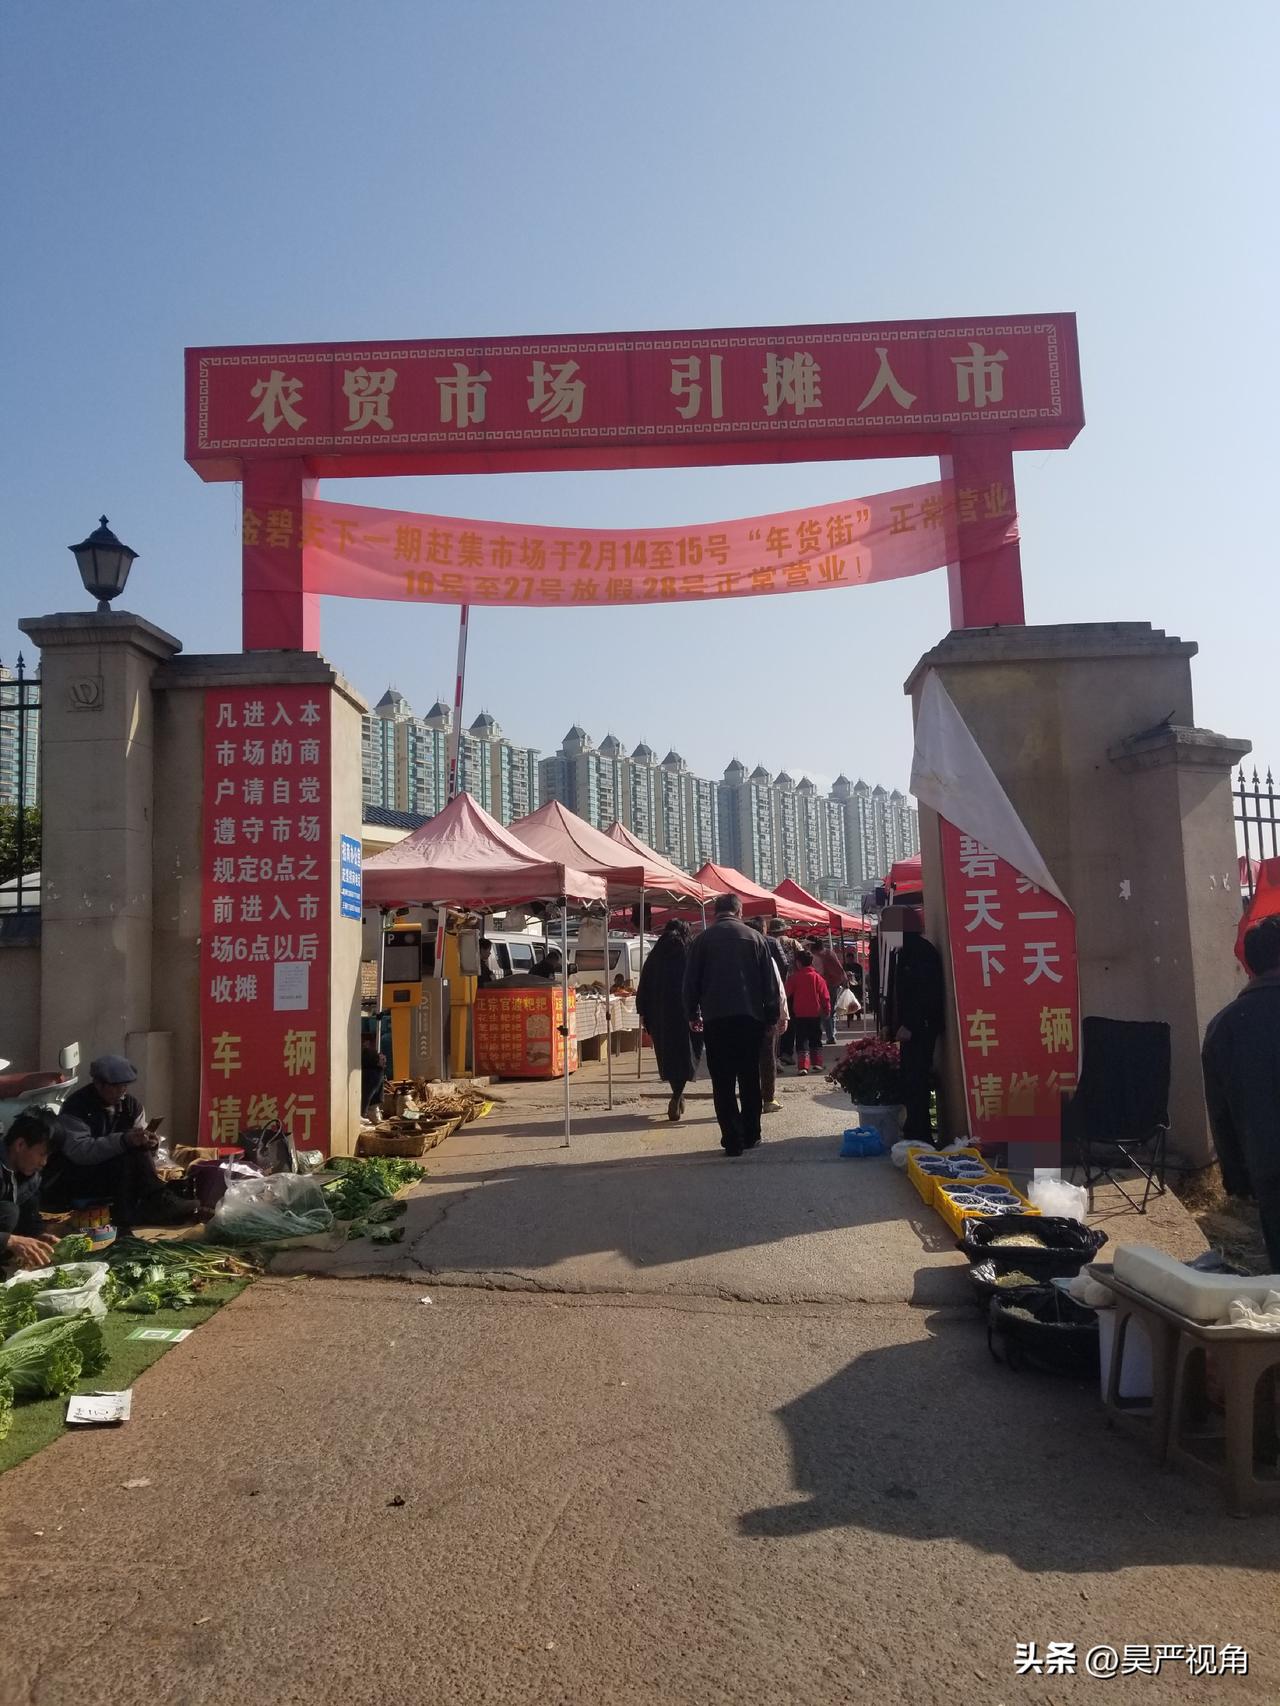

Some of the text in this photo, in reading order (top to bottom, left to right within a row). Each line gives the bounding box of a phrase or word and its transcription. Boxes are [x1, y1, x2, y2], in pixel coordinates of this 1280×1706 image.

[247, 342, 1009, 434] 农贸市场 引摊入市
[216, 700, 321, 728] 凡进入本
[216, 738, 321, 767] 市场的商
[214, 777, 321, 805] 户请自觉
[213, 816, 321, 845] 遵守市场
[212, 854, 319, 883] 规定8点之
[212, 893, 320, 924] 前进入市
[211, 933, 320, 963] 场6点以后
[210, 975, 257, 1003] 收摊
[208, 1092, 317, 1144] 请绕行
